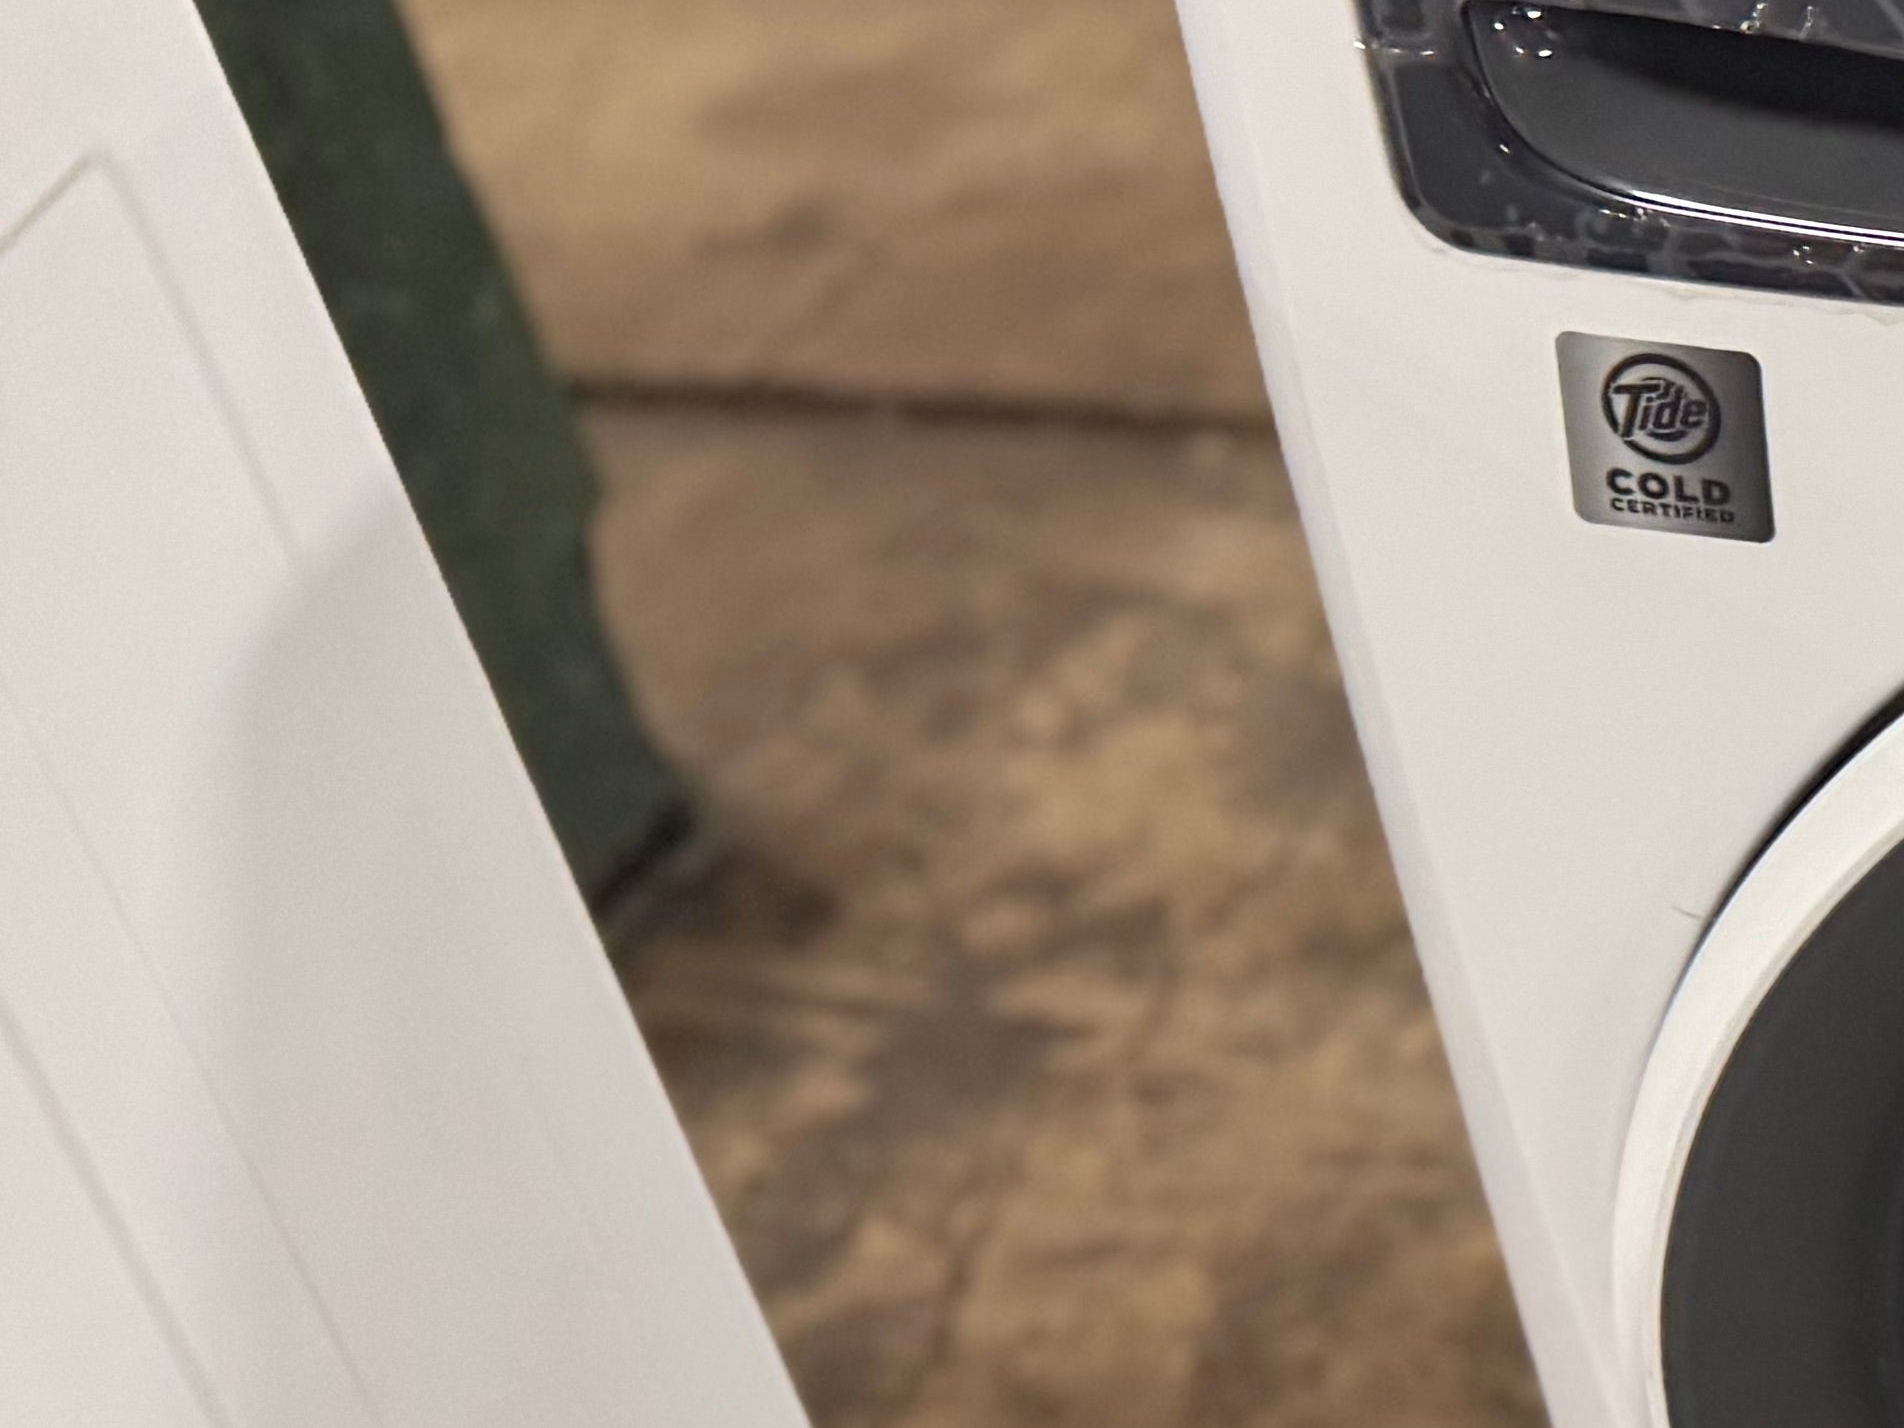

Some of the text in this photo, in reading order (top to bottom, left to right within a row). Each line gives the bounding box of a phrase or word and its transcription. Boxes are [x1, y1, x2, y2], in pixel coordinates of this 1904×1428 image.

[1612, 376, 1708, 441] Tide
[1606, 467, 1732, 506] COLD
[1610, 498, 1736, 524] CERTIFIED
